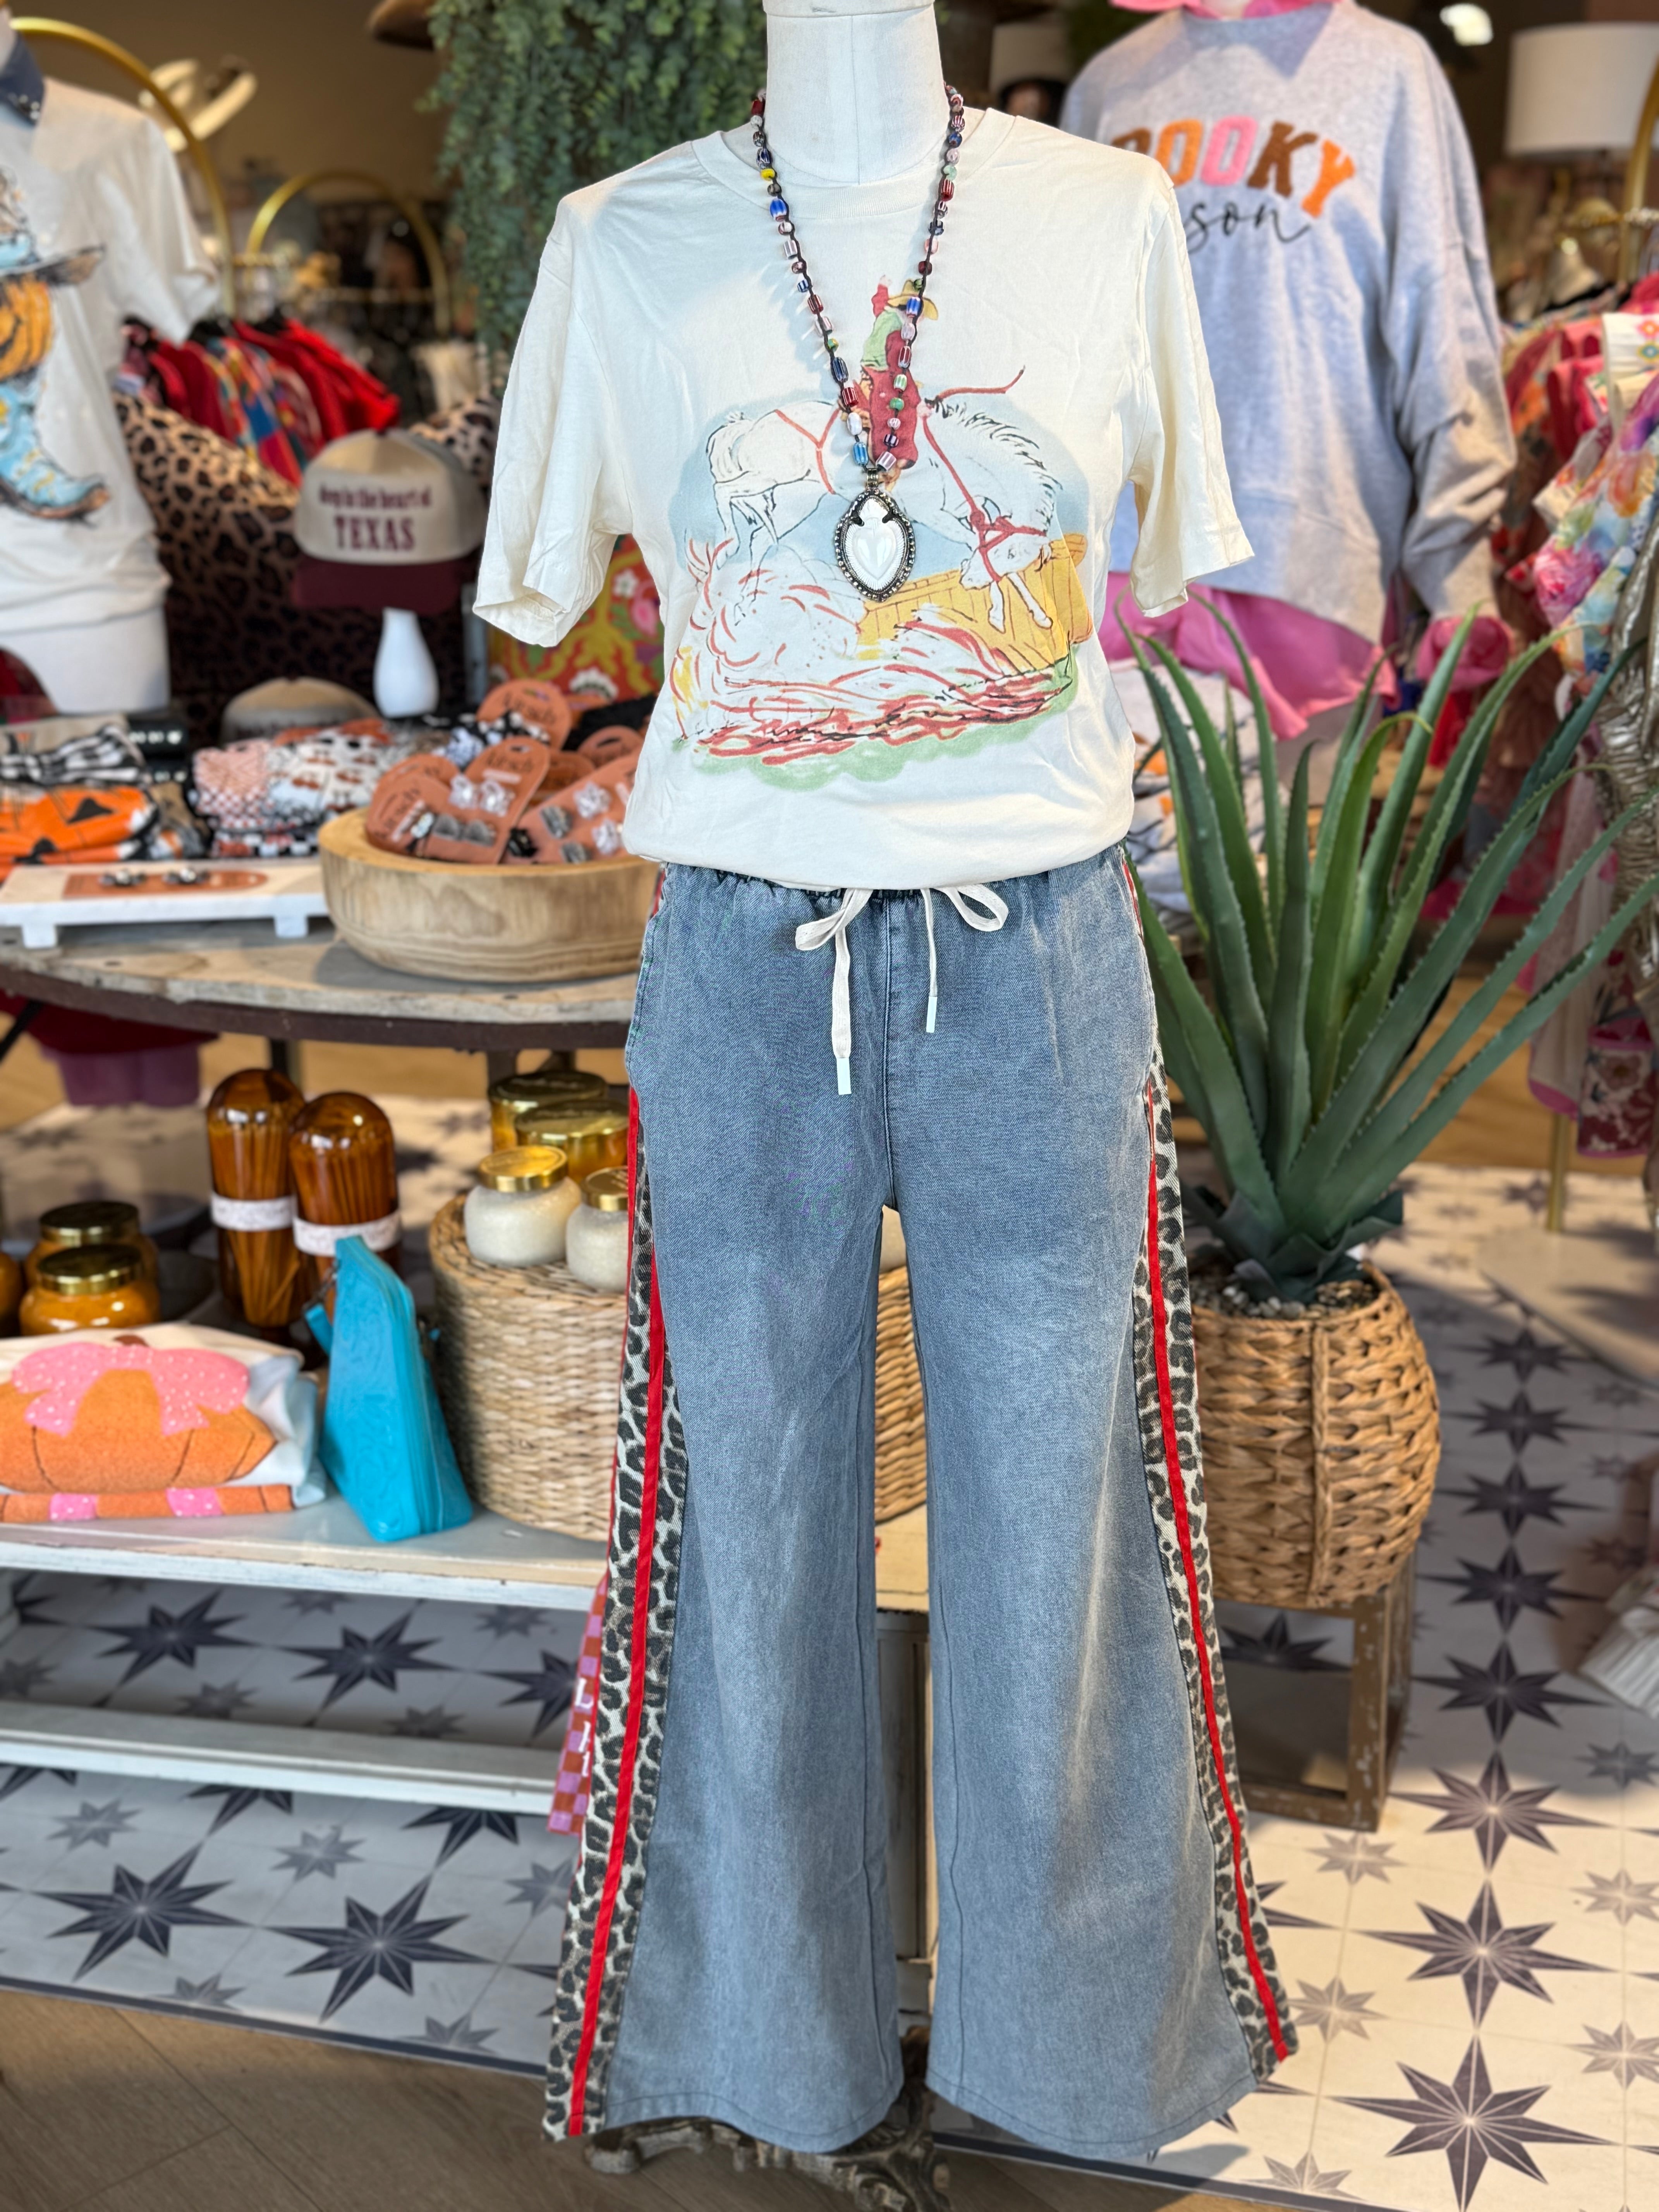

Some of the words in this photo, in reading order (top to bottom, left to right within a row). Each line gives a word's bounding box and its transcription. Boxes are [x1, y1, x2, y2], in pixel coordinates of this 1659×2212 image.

[1111, 115, 1356, 219] OOKY
[1182, 201, 1311, 255] son
[335, 516, 414, 550] TEXAS
